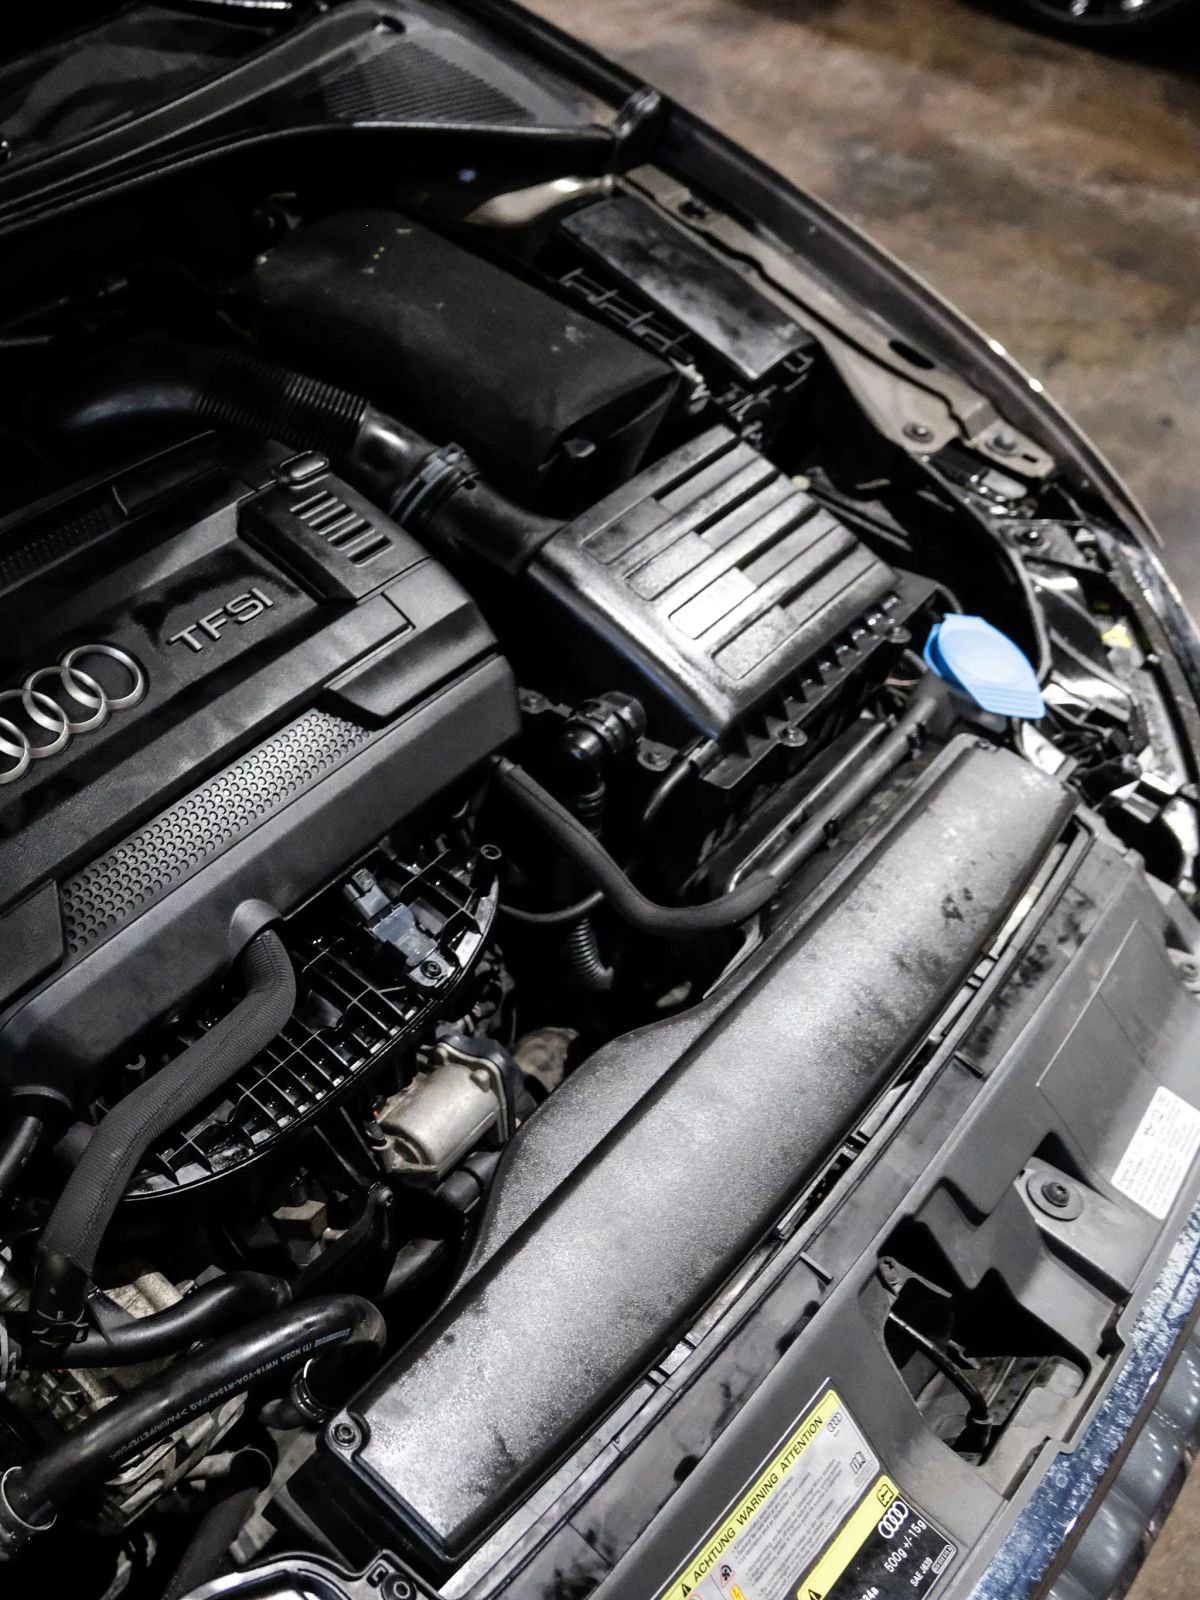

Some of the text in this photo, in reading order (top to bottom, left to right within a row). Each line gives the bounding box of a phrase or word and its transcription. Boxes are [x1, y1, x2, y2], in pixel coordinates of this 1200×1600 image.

[166, 587, 275, 653] TFSI
[693, 1526, 737, 1583] ACHTUNG
[736, 1473, 780, 1526] WARNING
[780, 1415, 824, 1472] ATTENTION
[883, 1548, 908, 1573] 500g
[909, 1570, 924, 1587] SAE
